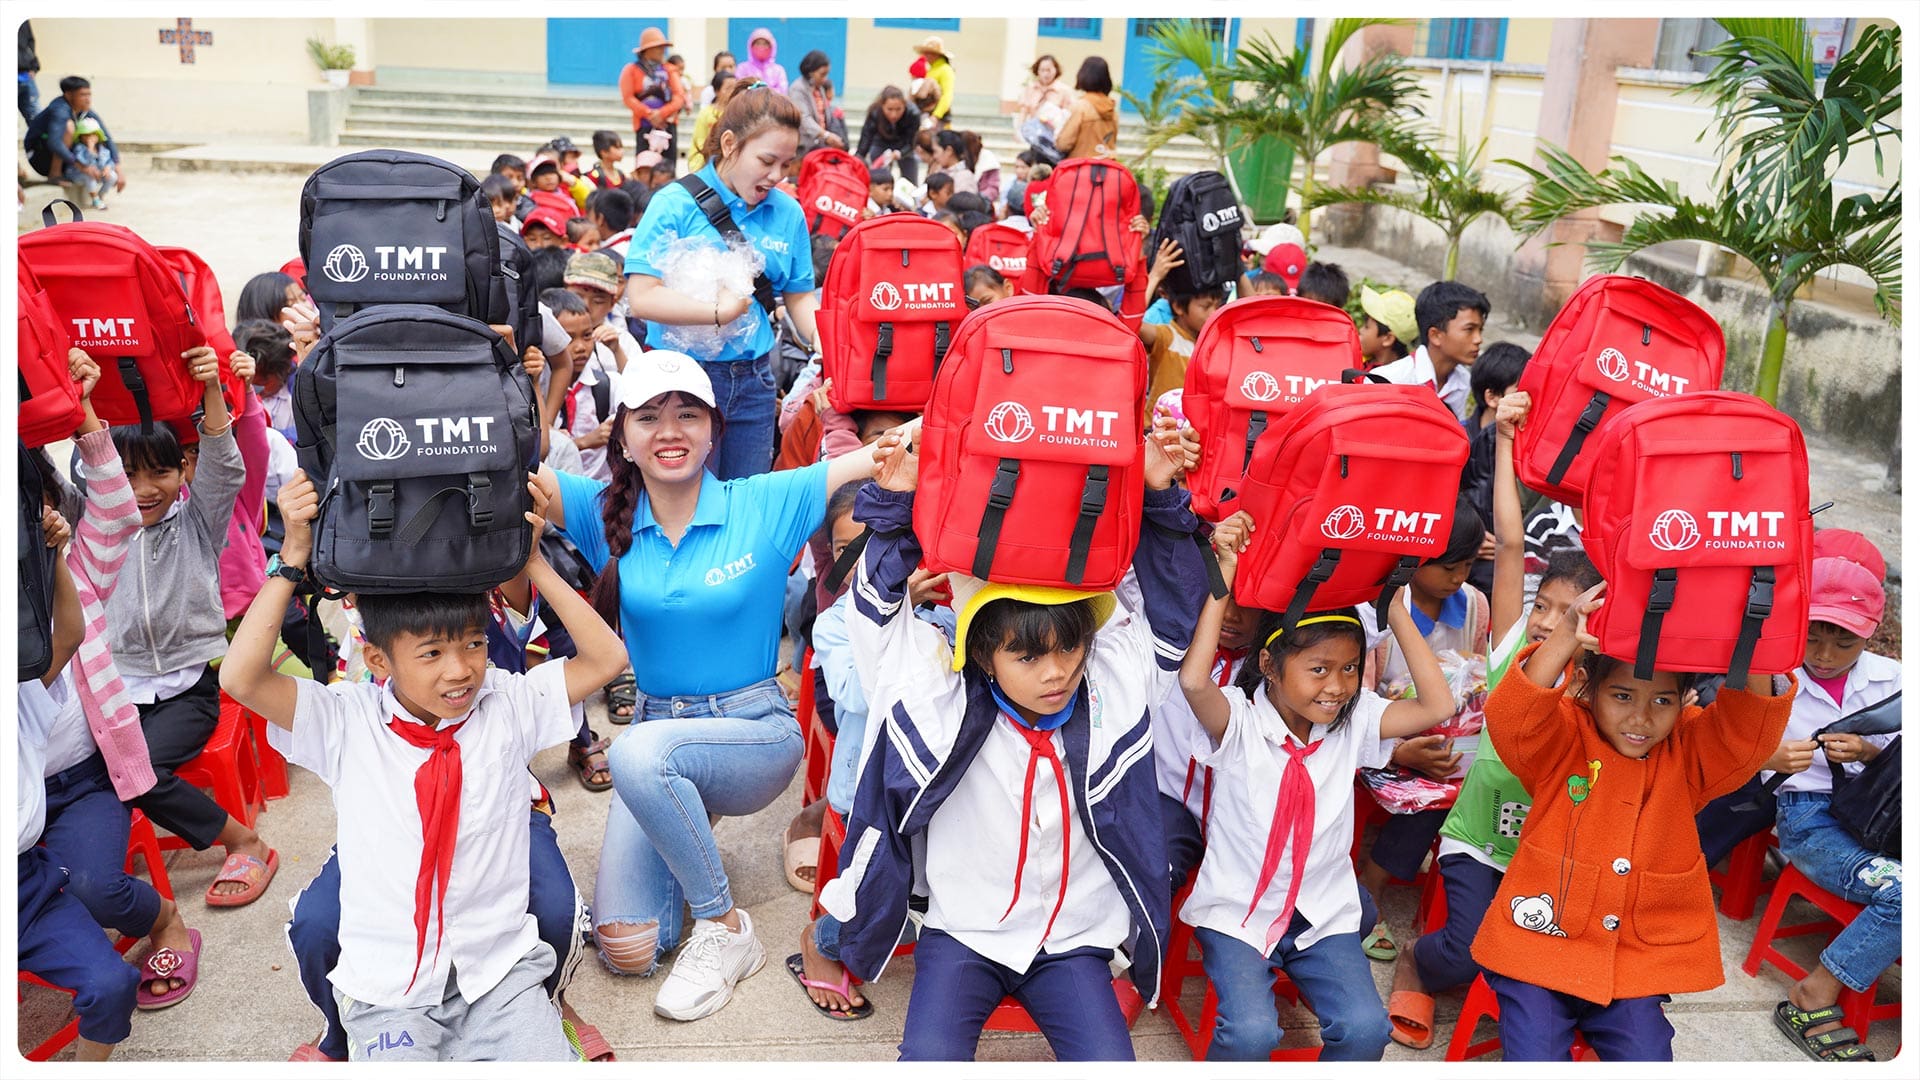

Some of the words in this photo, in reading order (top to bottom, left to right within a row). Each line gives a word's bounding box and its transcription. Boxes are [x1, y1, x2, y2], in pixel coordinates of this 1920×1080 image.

[375, 246, 447, 270] TMT
[374, 273, 447, 281] FOUNDATION
[903, 283, 955, 302] TMT
[904, 302, 956, 310] FOUNDATION
[72, 318, 135, 338] TMT
[75, 339, 139, 347] FOUNDATION
[1285, 375, 1342, 396] TM
[1634, 360, 1689, 395] TMT
[415, 416, 495, 444] TMT
[1042, 406, 1119, 436] TMT
[417, 445, 497, 456] FOUNDATION
[1039, 434, 1118, 448] FOUNDATION
[1374, 508, 1442, 535] TMT
[1707, 511, 1785, 537] TMT
[1367, 532, 1435, 545] FOUNDATION
[1705, 540, 1785, 549] FOUNDATION
[724, 552, 753, 576] TMT
[366, 1030, 415, 1059] FILA
